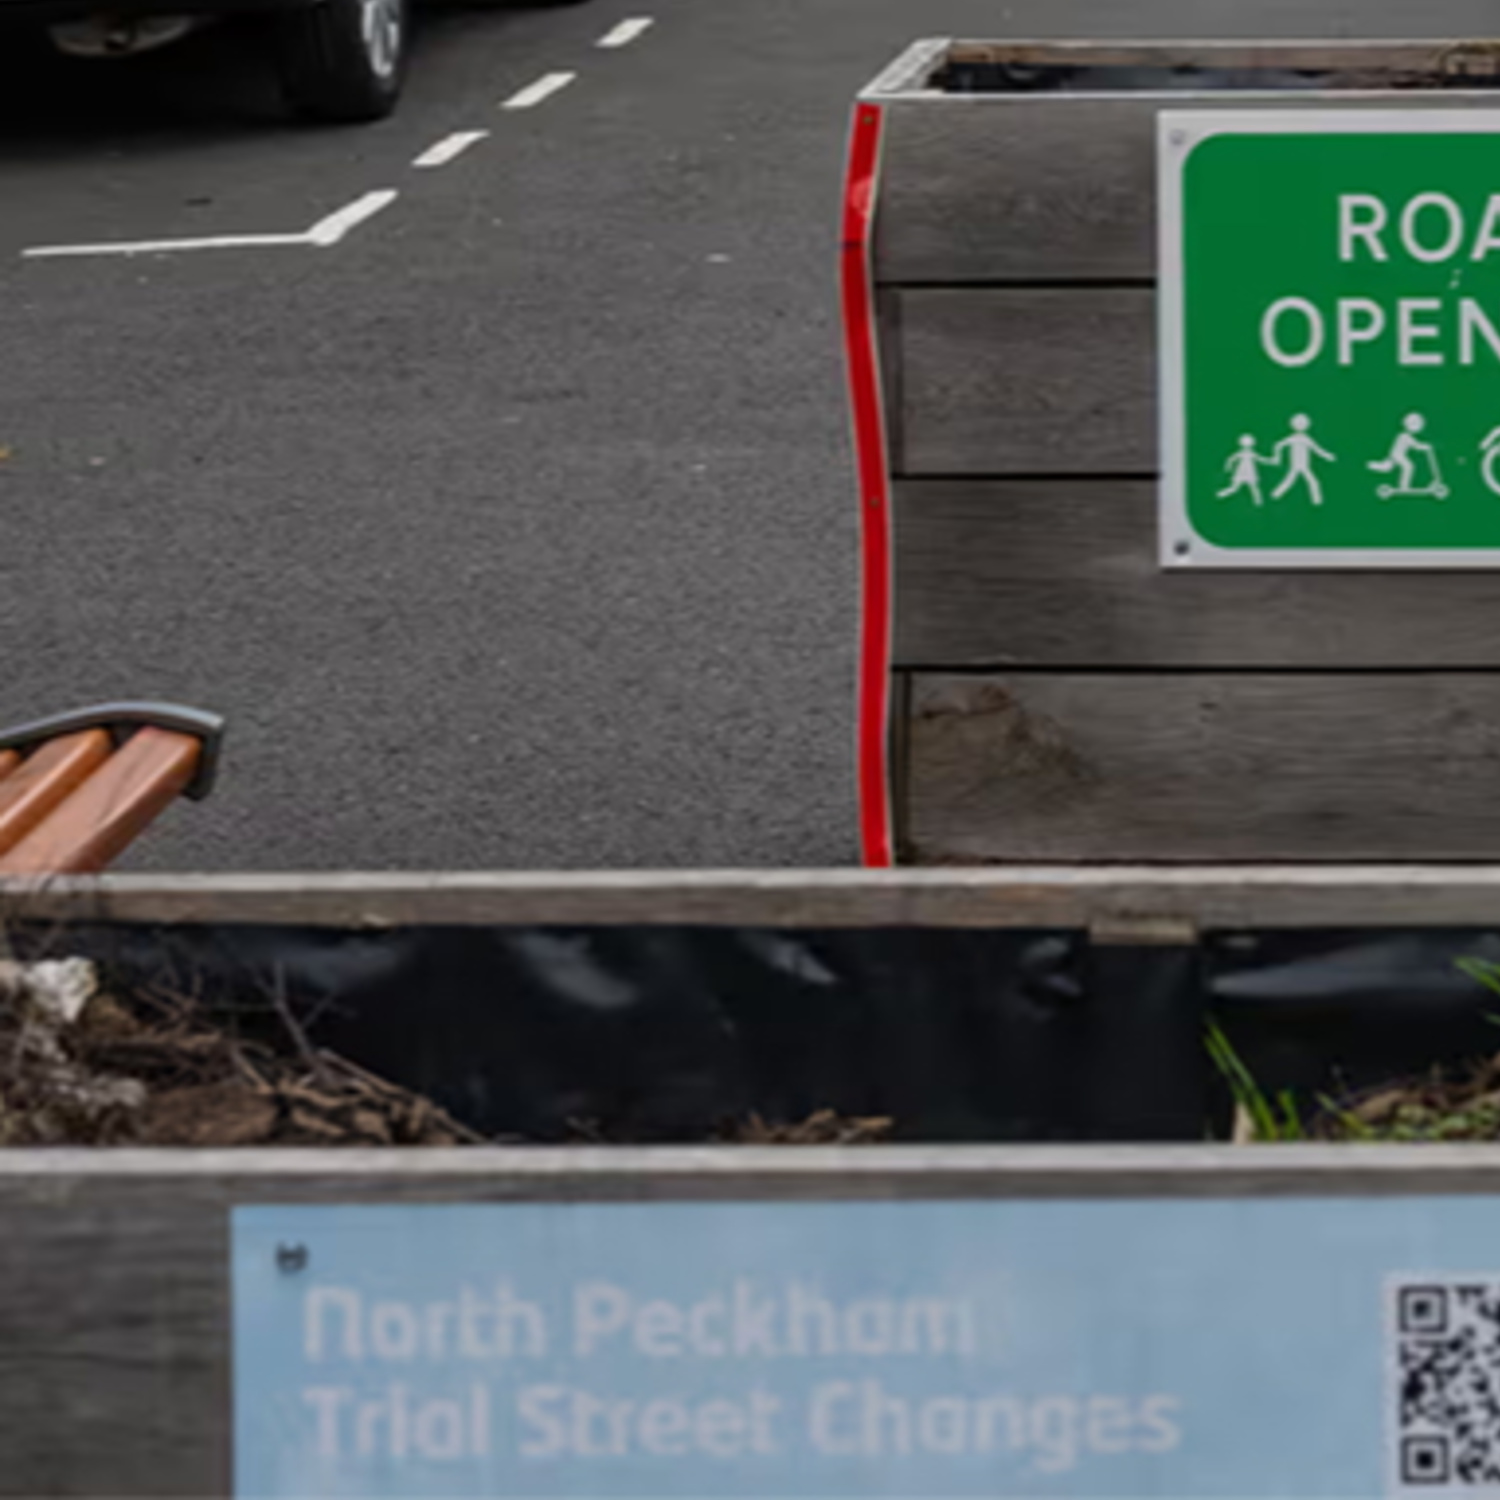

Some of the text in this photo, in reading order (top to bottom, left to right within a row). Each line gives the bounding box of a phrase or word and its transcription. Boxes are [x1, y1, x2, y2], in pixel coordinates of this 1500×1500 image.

[303, 1278, 978, 1360] North Peckham
[302, 1378, 1183, 1474] Trial Street Changes
